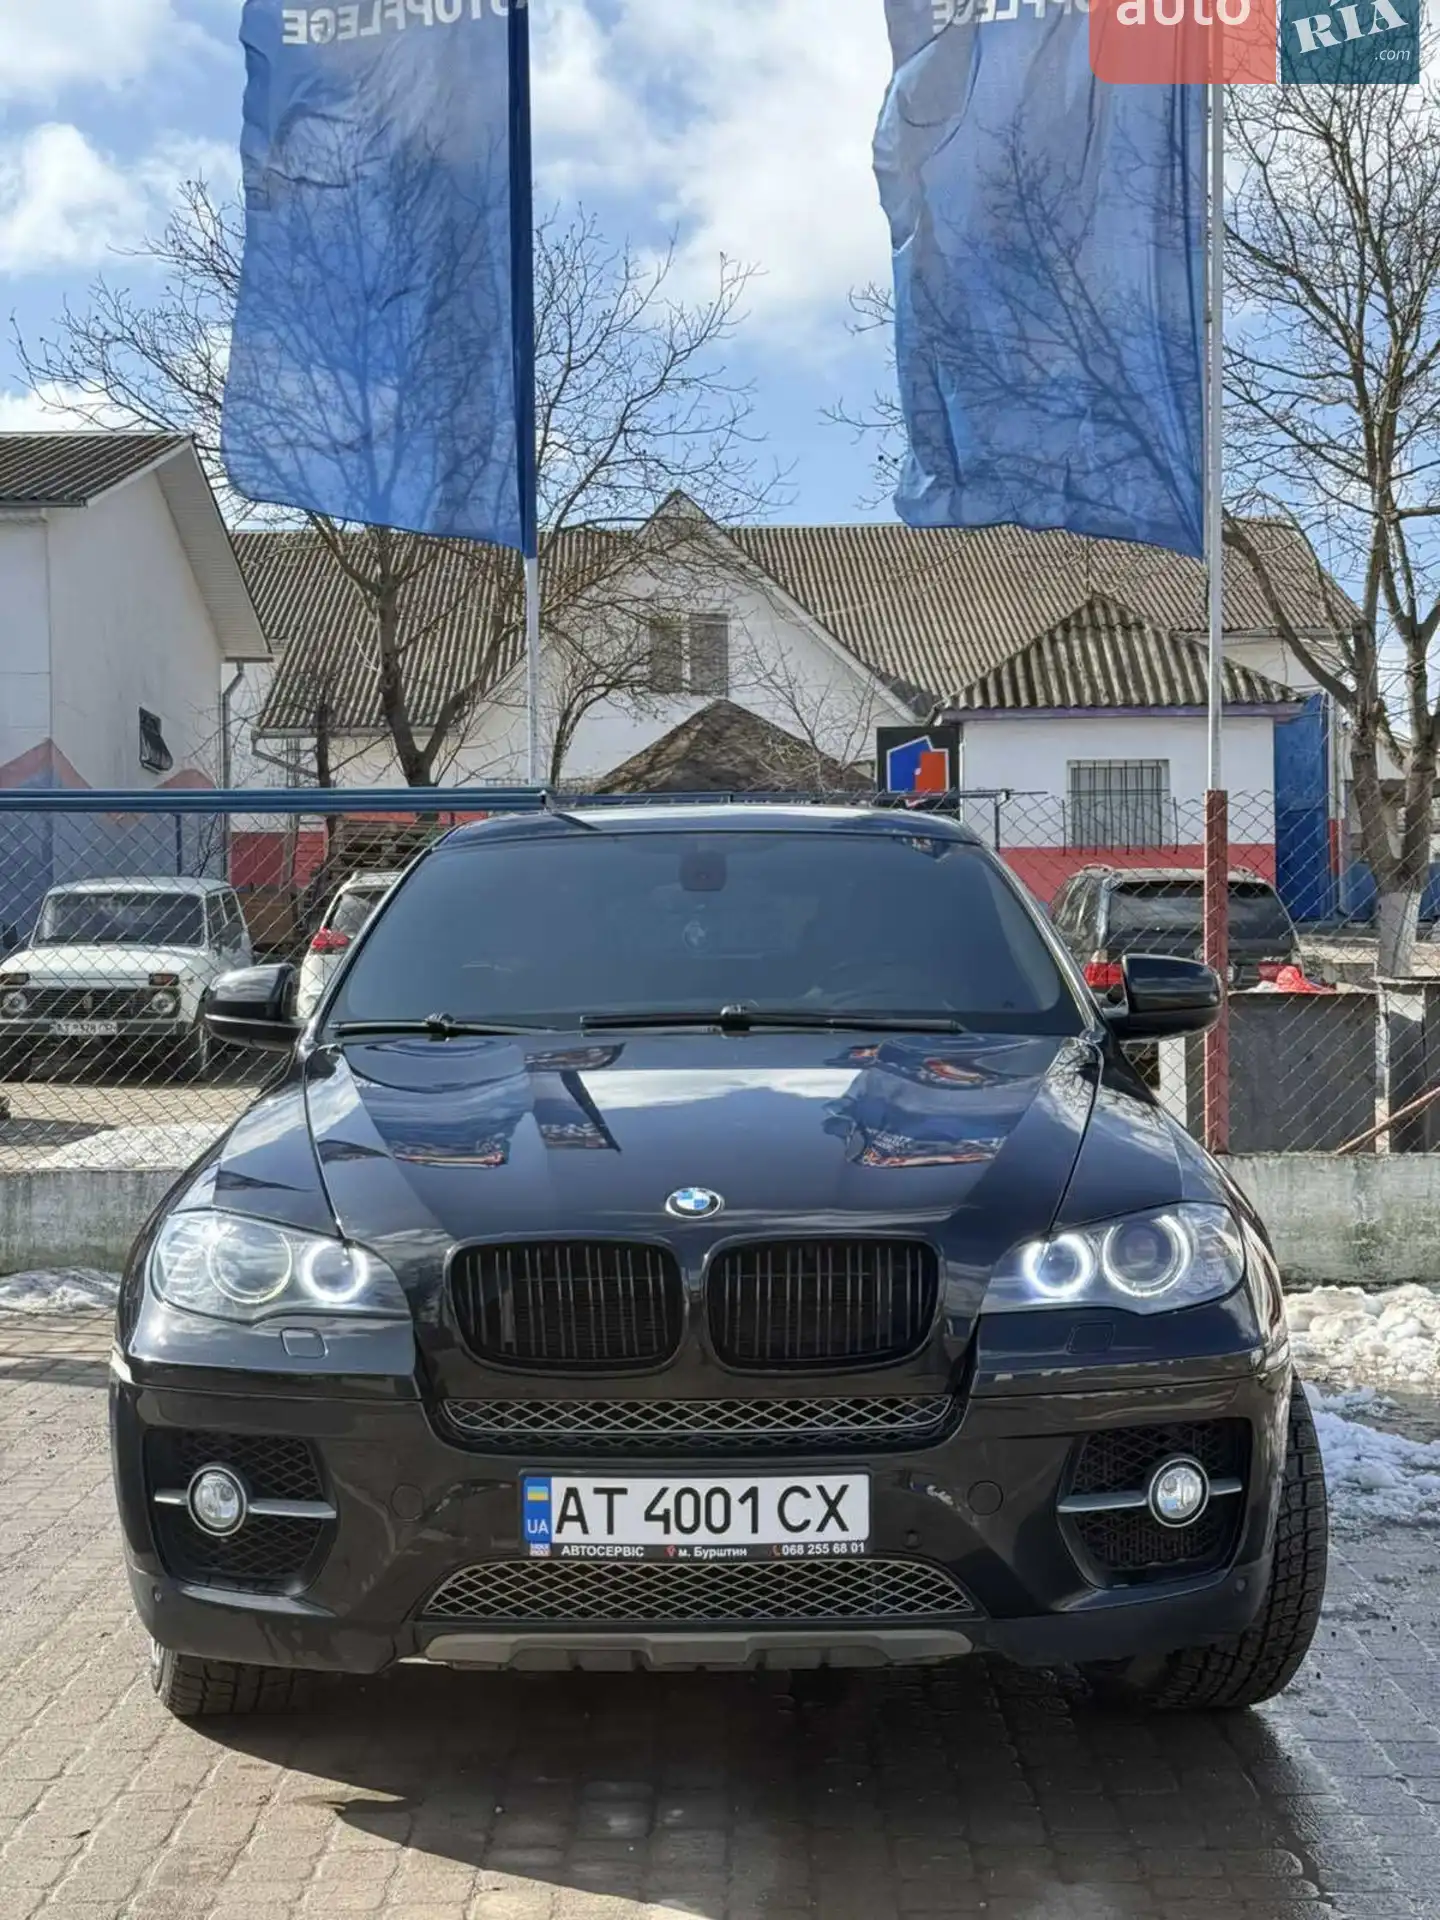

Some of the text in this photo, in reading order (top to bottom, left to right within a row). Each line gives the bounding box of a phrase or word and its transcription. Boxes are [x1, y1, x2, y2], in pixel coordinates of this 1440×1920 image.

[555, 1484, 849, 1535] AT 4001 CX
[527, 1519, 549, 1534] UA
[561, 1545, 645, 1557] АВТОСЕРВІС
[693, 1546, 748, 1559] Бурштин
[781, 1543, 804, 1556] 068
[807, 1543, 830, 1555] 255
[832, 1542, 848, 1554] 68
[850, 1541, 865, 1553] 01
